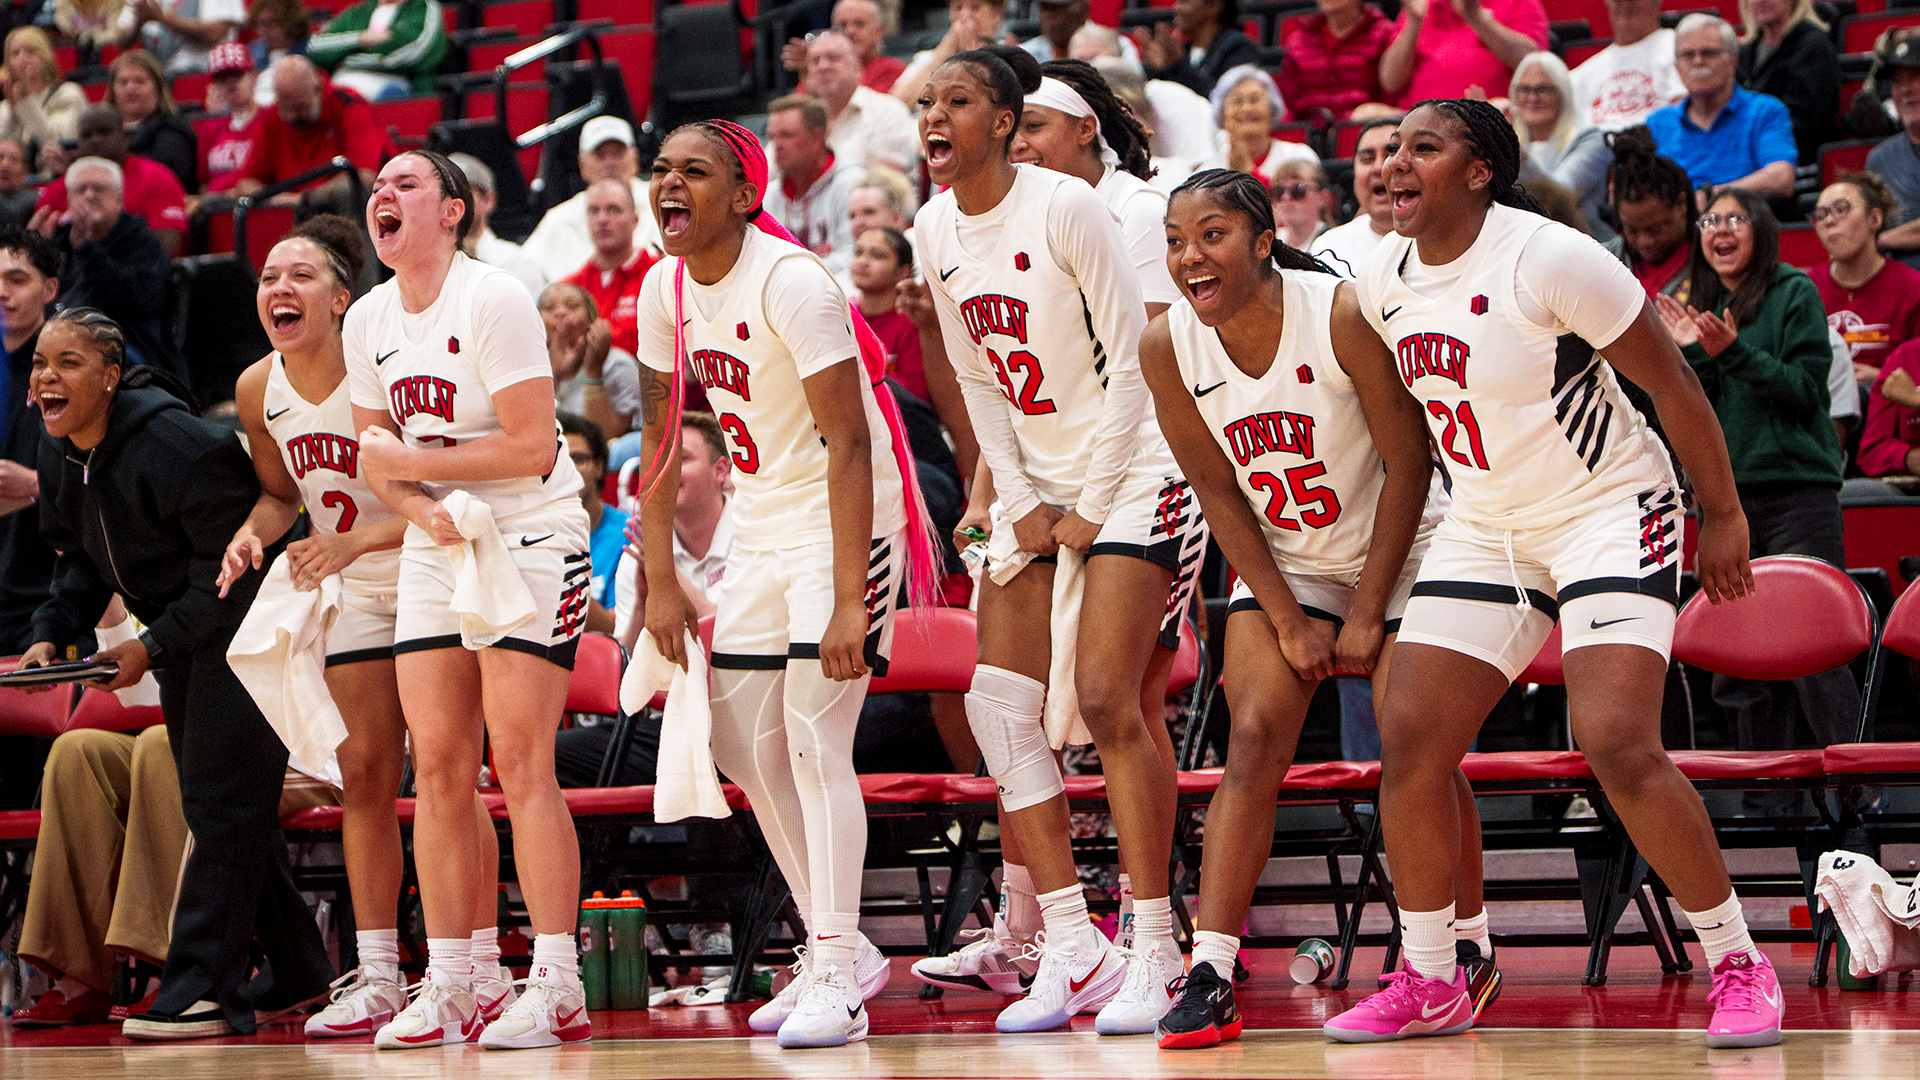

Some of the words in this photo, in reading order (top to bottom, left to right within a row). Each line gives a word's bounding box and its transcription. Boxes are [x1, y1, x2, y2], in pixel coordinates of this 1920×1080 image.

[960, 293, 1029, 345] UNLV
[692, 348, 751, 402] UNLV
[986, 347, 1058, 415] 32
[1397, 332, 1471, 389] UNLV
[390, 375, 457, 426] UNLV
[286, 432, 360, 480] UNLV
[719, 412, 760, 475] 3
[1223, 411, 1316, 467] UNLV
[1427, 400, 1491, 471] 21
[1247, 460, 1342, 532] 25
